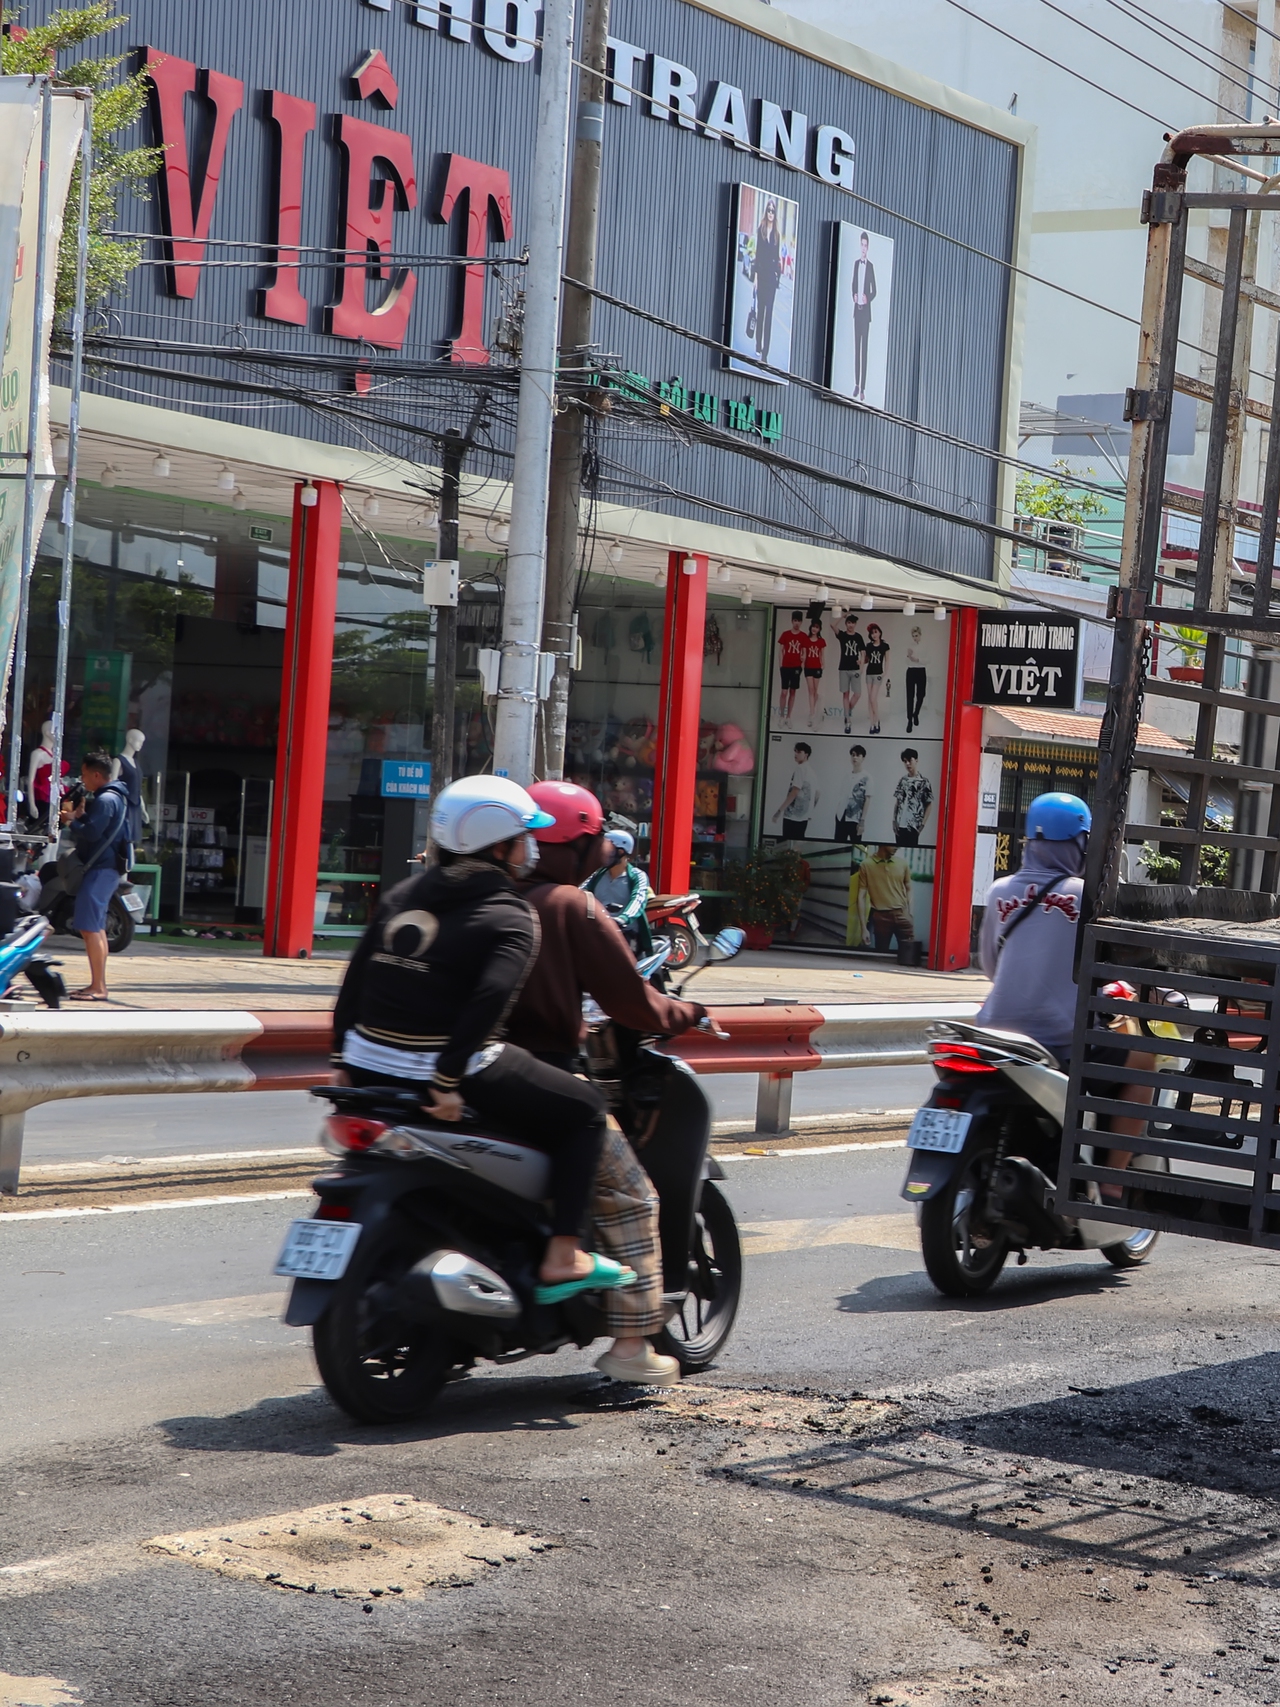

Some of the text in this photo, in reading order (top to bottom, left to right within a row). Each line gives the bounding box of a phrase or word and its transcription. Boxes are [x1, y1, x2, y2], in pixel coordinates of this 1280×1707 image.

[606, 35, 855, 191] TRANG
[140, 46, 514, 396] VIỆT
[728, 396, 756, 433] TRẢ
[761, 410, 783, 444] LẠI
[981, 620, 1075, 650] TRUNG TÂM THỜI TRANG
[987, 656, 1063, 704] VIỆT
